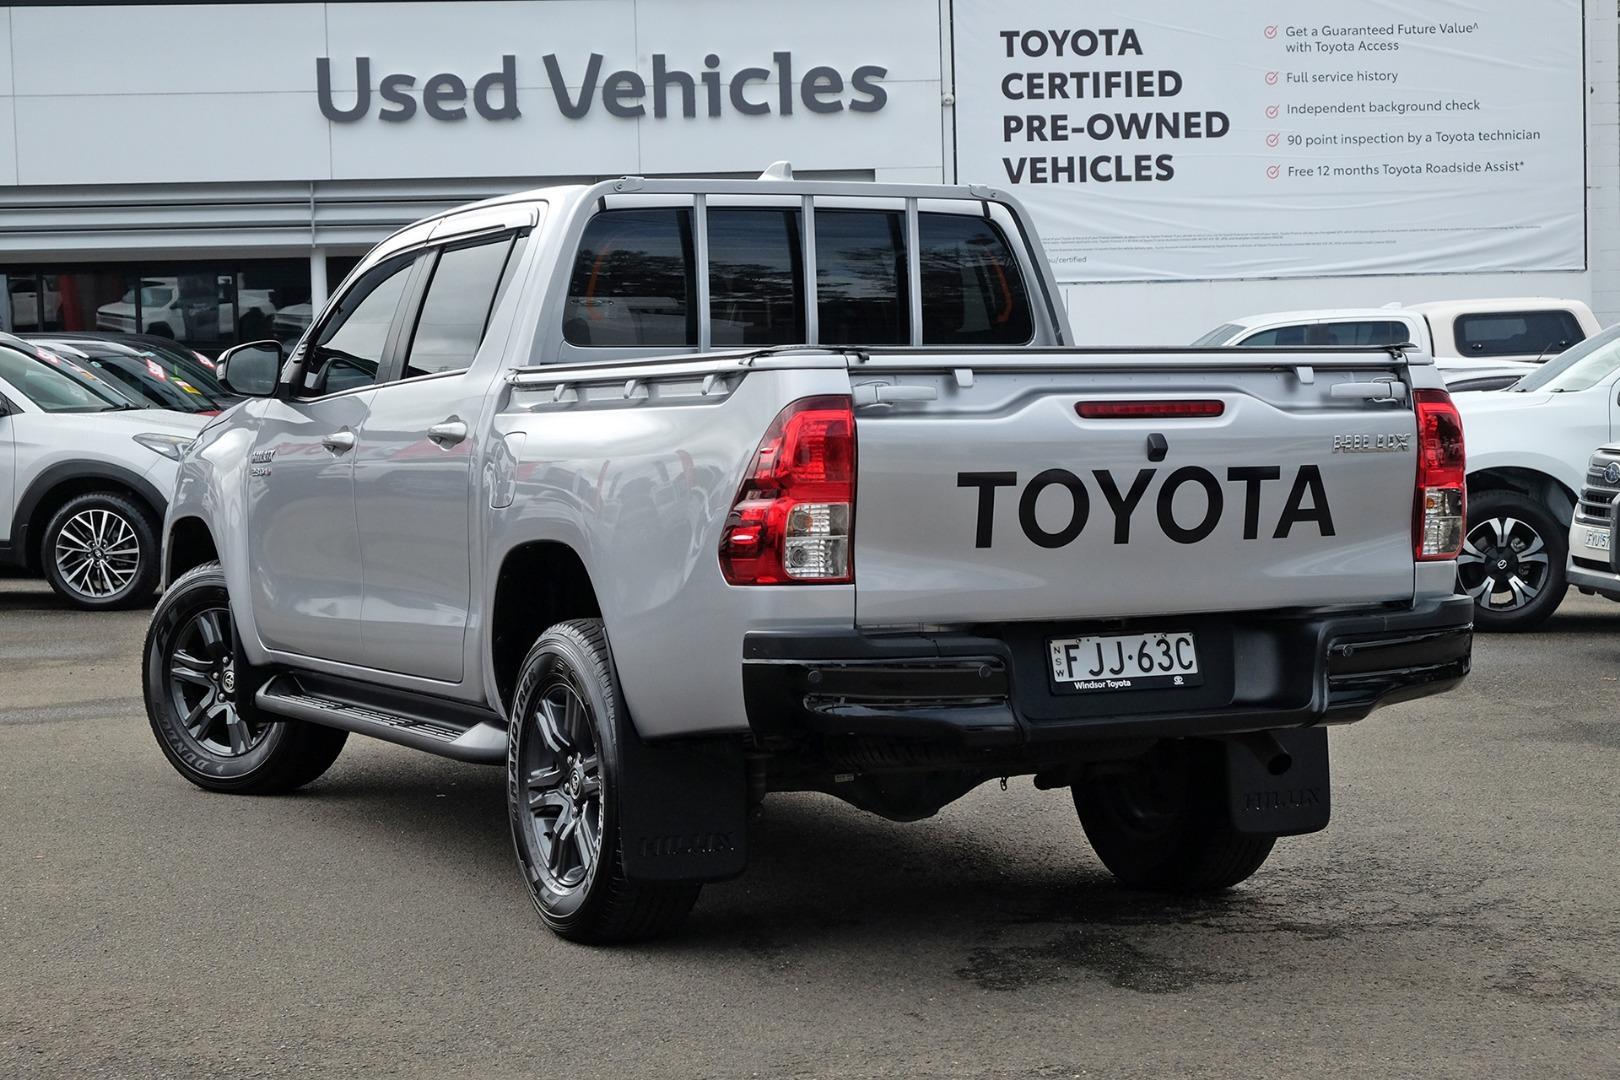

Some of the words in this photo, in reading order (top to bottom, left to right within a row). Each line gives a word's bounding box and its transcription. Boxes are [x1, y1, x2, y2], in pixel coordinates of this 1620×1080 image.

[1285, 25, 1308, 38] Get
[1310, 28, 1319, 37] a
[1321, 23, 1394, 37] Guaranteed
[1397, 23, 1437, 35] Future
[999, 28, 1144, 58] TOYOTA
[1285, 41, 1312, 53] with
[1314, 41, 1355, 55] Toyota
[1357, 40, 1400, 52] Access
[1001, 69, 1183, 101] CERTIFIED
[1286, 71, 1309, 84] Full
[1311, 72, 1354, 83] service
[1356, 70, 1399, 84] history
[316, 54, 522, 125] Used
[542, 51, 888, 122] Vehicles
[1287, 101, 1366, 117] Independent
[1368, 99, 1442, 115] background
[1444, 99, 1481, 111] check
[1003, 111, 1230, 143] PRE-OWNED
[1287, 134, 1303, 146] 90
[1305, 133, 1339, 148] point
[1340, 132, 1404, 147] inspection
[1407, 131, 1423, 146] by
[1424, 134, 1433, 143] a
[1435, 131, 1475, 145] Toyota
[1478, 129, 1541, 142] technician
[1002, 153, 1175, 185] VEHICLES
[1287, 165, 1315, 177] Free
[1316, 165, 1331, 177] 12
[1333, 164, 1380, 176] months
[1381, 163, 1423, 178] Toyota
[1425, 161, 1482, 174] Roadside
[956, 464, 1336, 549] TOYOTA
[1074, 681, 1106, 690] Windsor
[1106, 679, 1132, 689] Toyota
